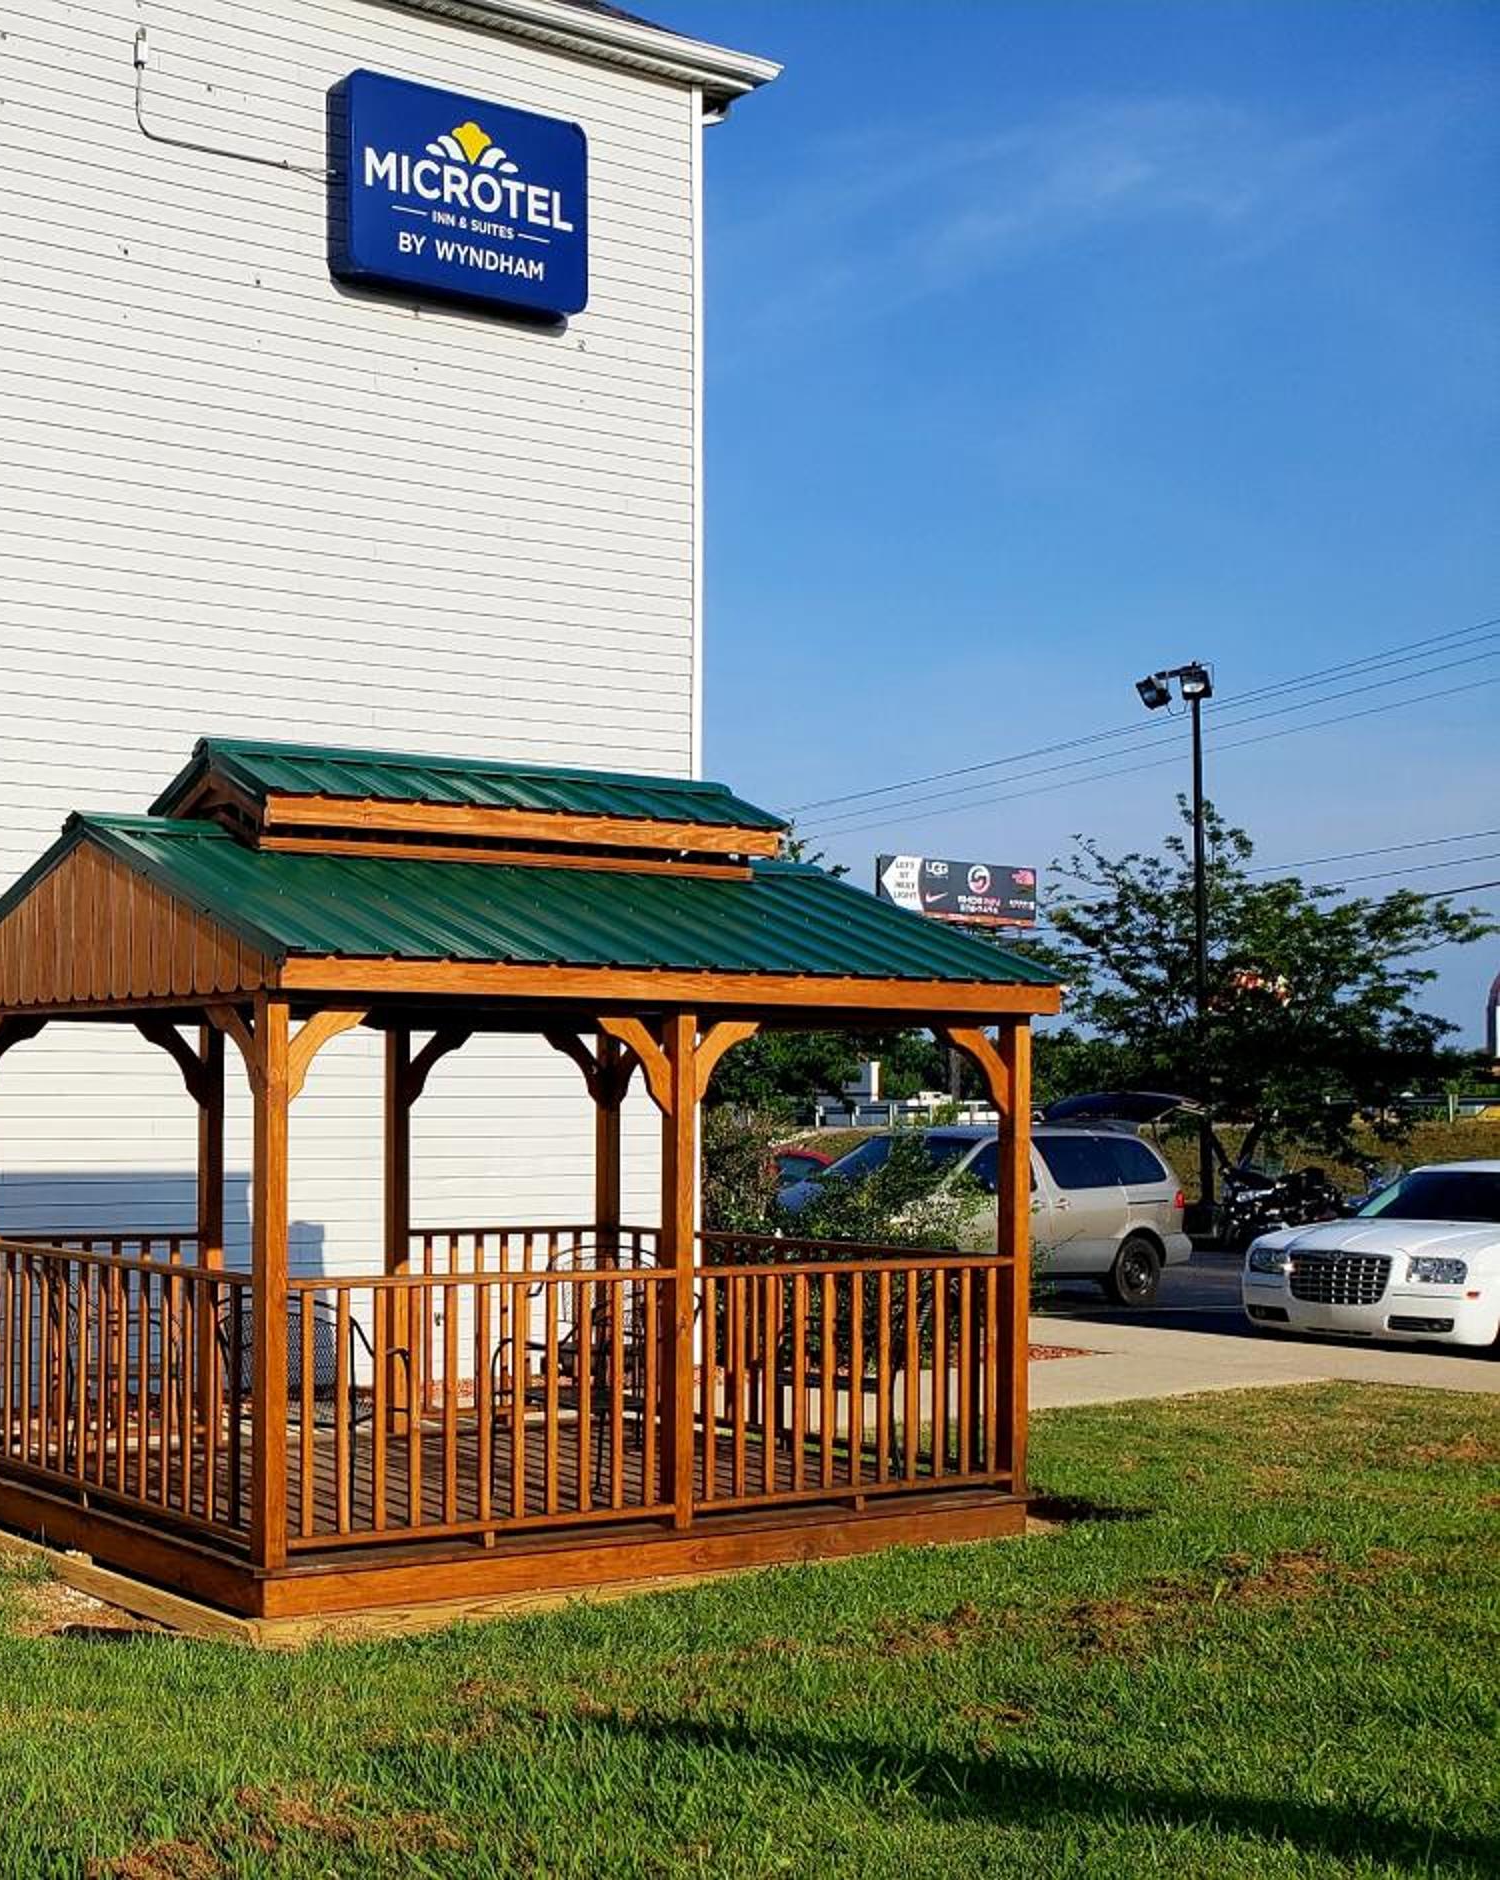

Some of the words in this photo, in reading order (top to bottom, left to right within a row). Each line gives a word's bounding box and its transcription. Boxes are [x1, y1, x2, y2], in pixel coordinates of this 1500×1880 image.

[364, 146, 574, 233] MICROTEL
[431, 209, 456, 226] INN
[458, 214, 468, 229] &
[470, 218, 516, 241] SUITES
[398, 231, 426, 255] BY
[434, 239, 545, 281] WYNDHAM
